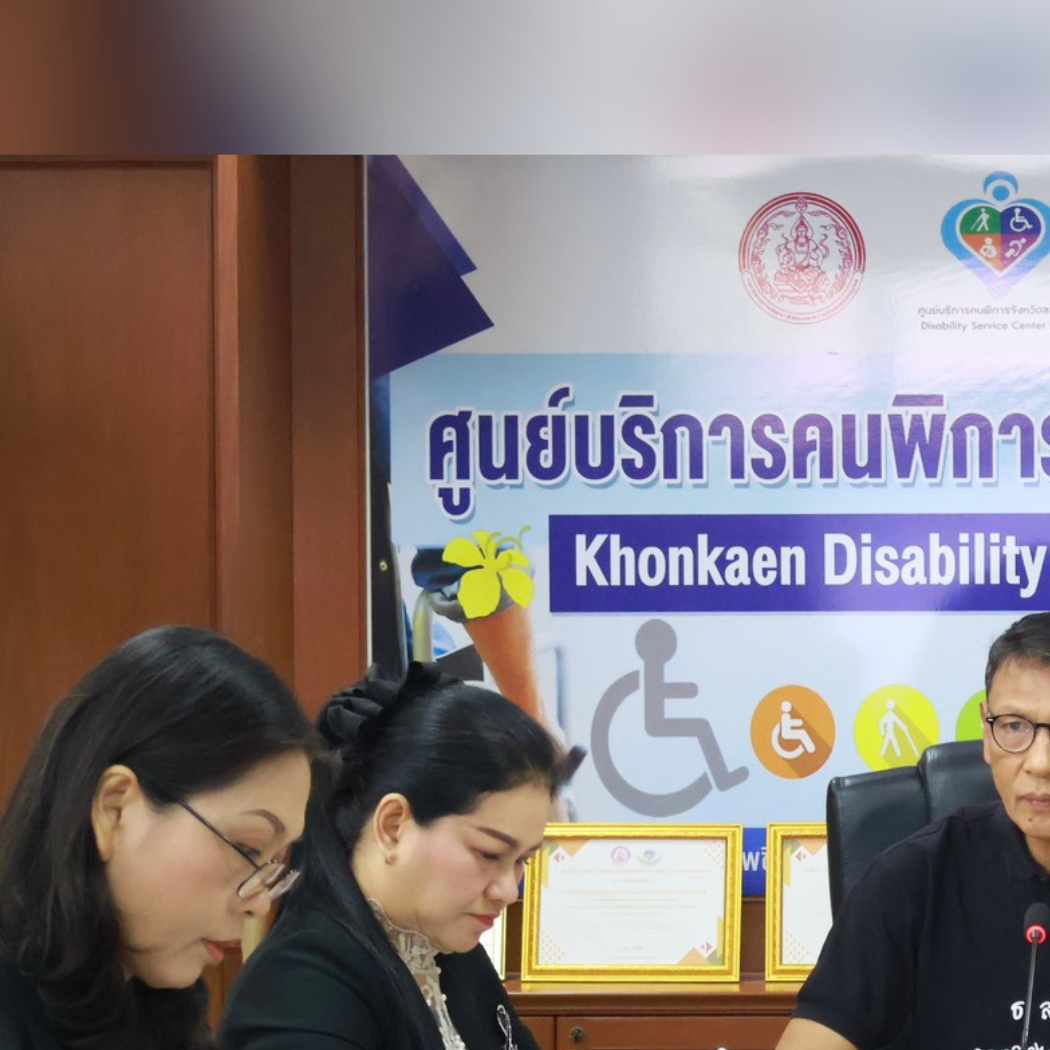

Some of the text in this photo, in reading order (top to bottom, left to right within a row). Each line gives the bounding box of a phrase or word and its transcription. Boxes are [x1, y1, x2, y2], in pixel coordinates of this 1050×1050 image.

[920, 320, 968, 333] Disability
[971, 320, 1008, 331] Service
[1011, 320, 1046, 331] Center
[574, 534, 806, 587] Khonkaen
[823, 533, 1047, 598] Disability
